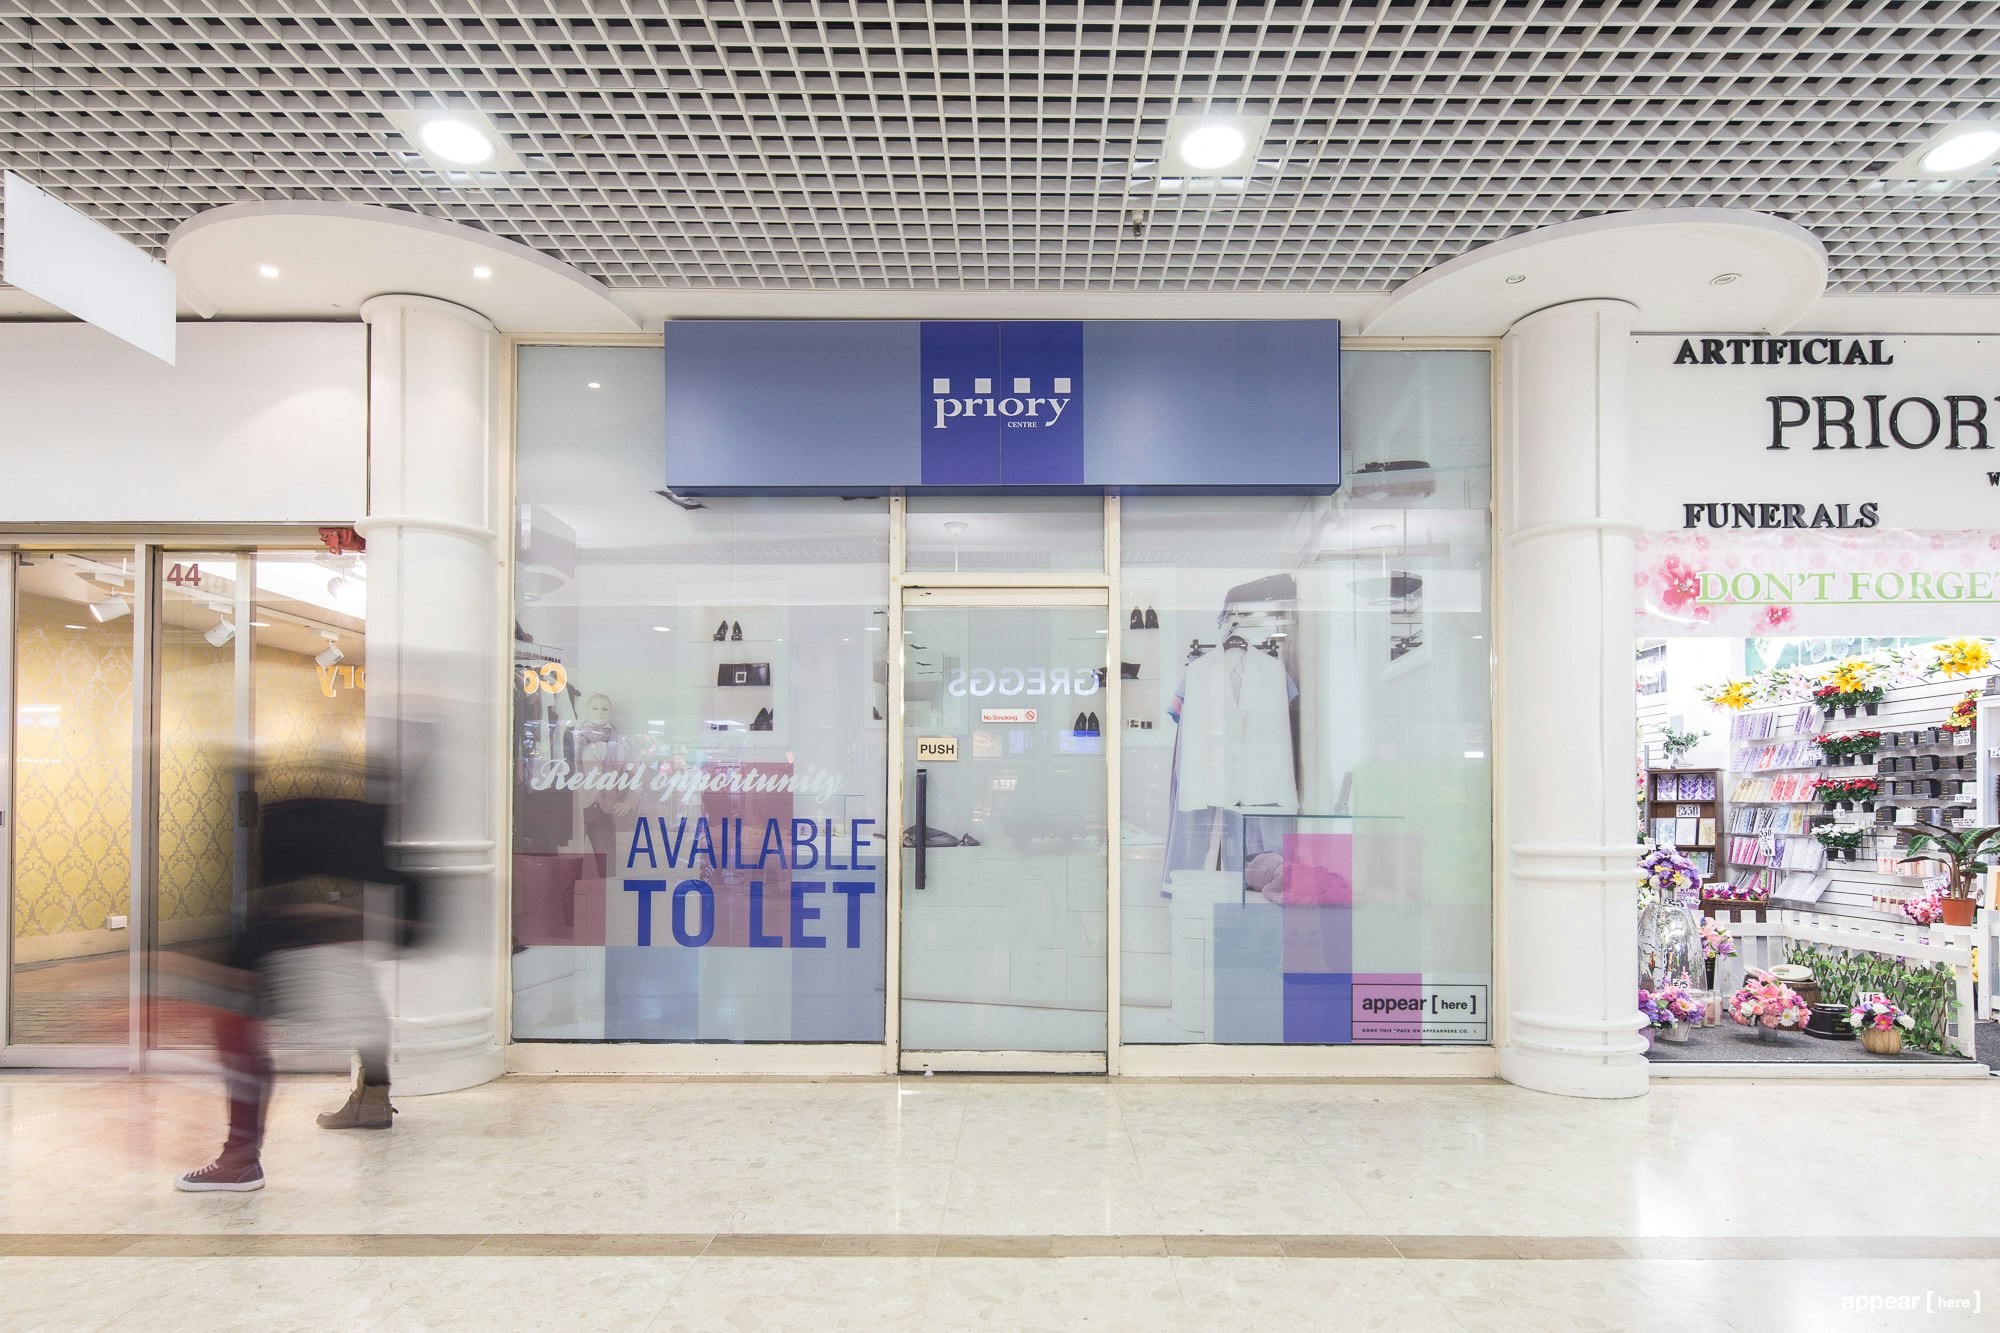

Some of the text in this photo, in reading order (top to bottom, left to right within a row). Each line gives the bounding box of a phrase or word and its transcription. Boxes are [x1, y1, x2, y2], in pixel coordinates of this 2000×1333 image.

[1673, 338, 1894, 366] ARTIFICIAL
[934, 397, 1071, 429] priory
[1765, 394, 2000, 451] PRIOR
[1683, 502, 1880, 529] FUNERALS
[167, 563, 202, 587] 44
[993, 714, 1018, 722] Smoking
[920, 744, 955, 755] PUSH
[530, 758, 843, 804] Retail opportunity
[626, 816, 876, 871] AVAILABLE
[624, 879, 876, 948] TO LET
[1362, 997, 1427, 1014] appear
